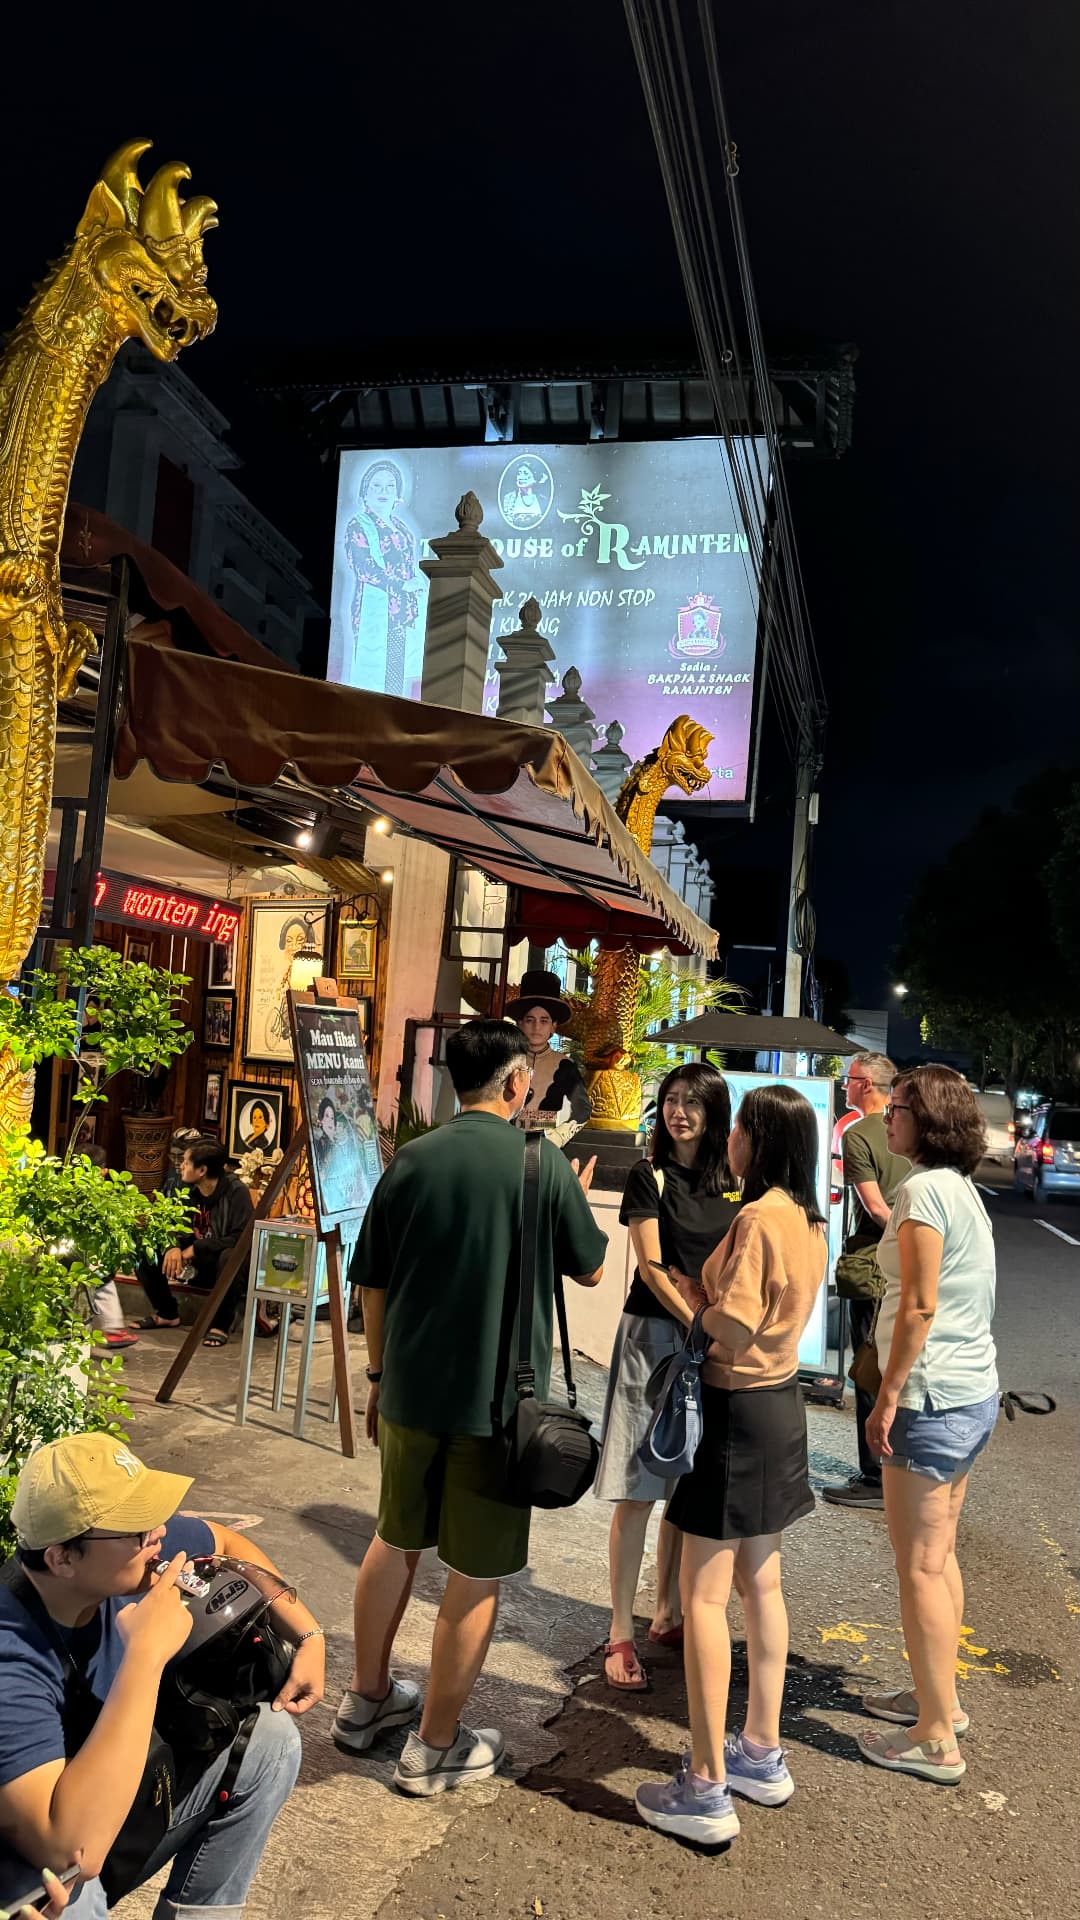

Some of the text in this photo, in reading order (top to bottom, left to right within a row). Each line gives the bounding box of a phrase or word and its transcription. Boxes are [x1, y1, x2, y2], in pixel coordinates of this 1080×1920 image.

[495, 523, 749, 571] OUSE of RAMINTEN
[539, 590, 570, 609] JAM
[576, 590, 614, 609] NON
[617, 588, 656, 608] STOP
[499, 617, 561, 636] KUNG
[680, 662, 711, 672] Sedia
[697, 674, 706, 683] &
[709, 673, 751, 683] SNACK
[662, 685, 733, 695] RAMINTEN
[123, 888, 199, 927] wonten
[201, 903, 238, 942] ing
[309, 1029, 357, 1048] Mau lihat
[305, 1052, 366, 1070] MENU kami
[210, 1580, 246, 1611] NJS
